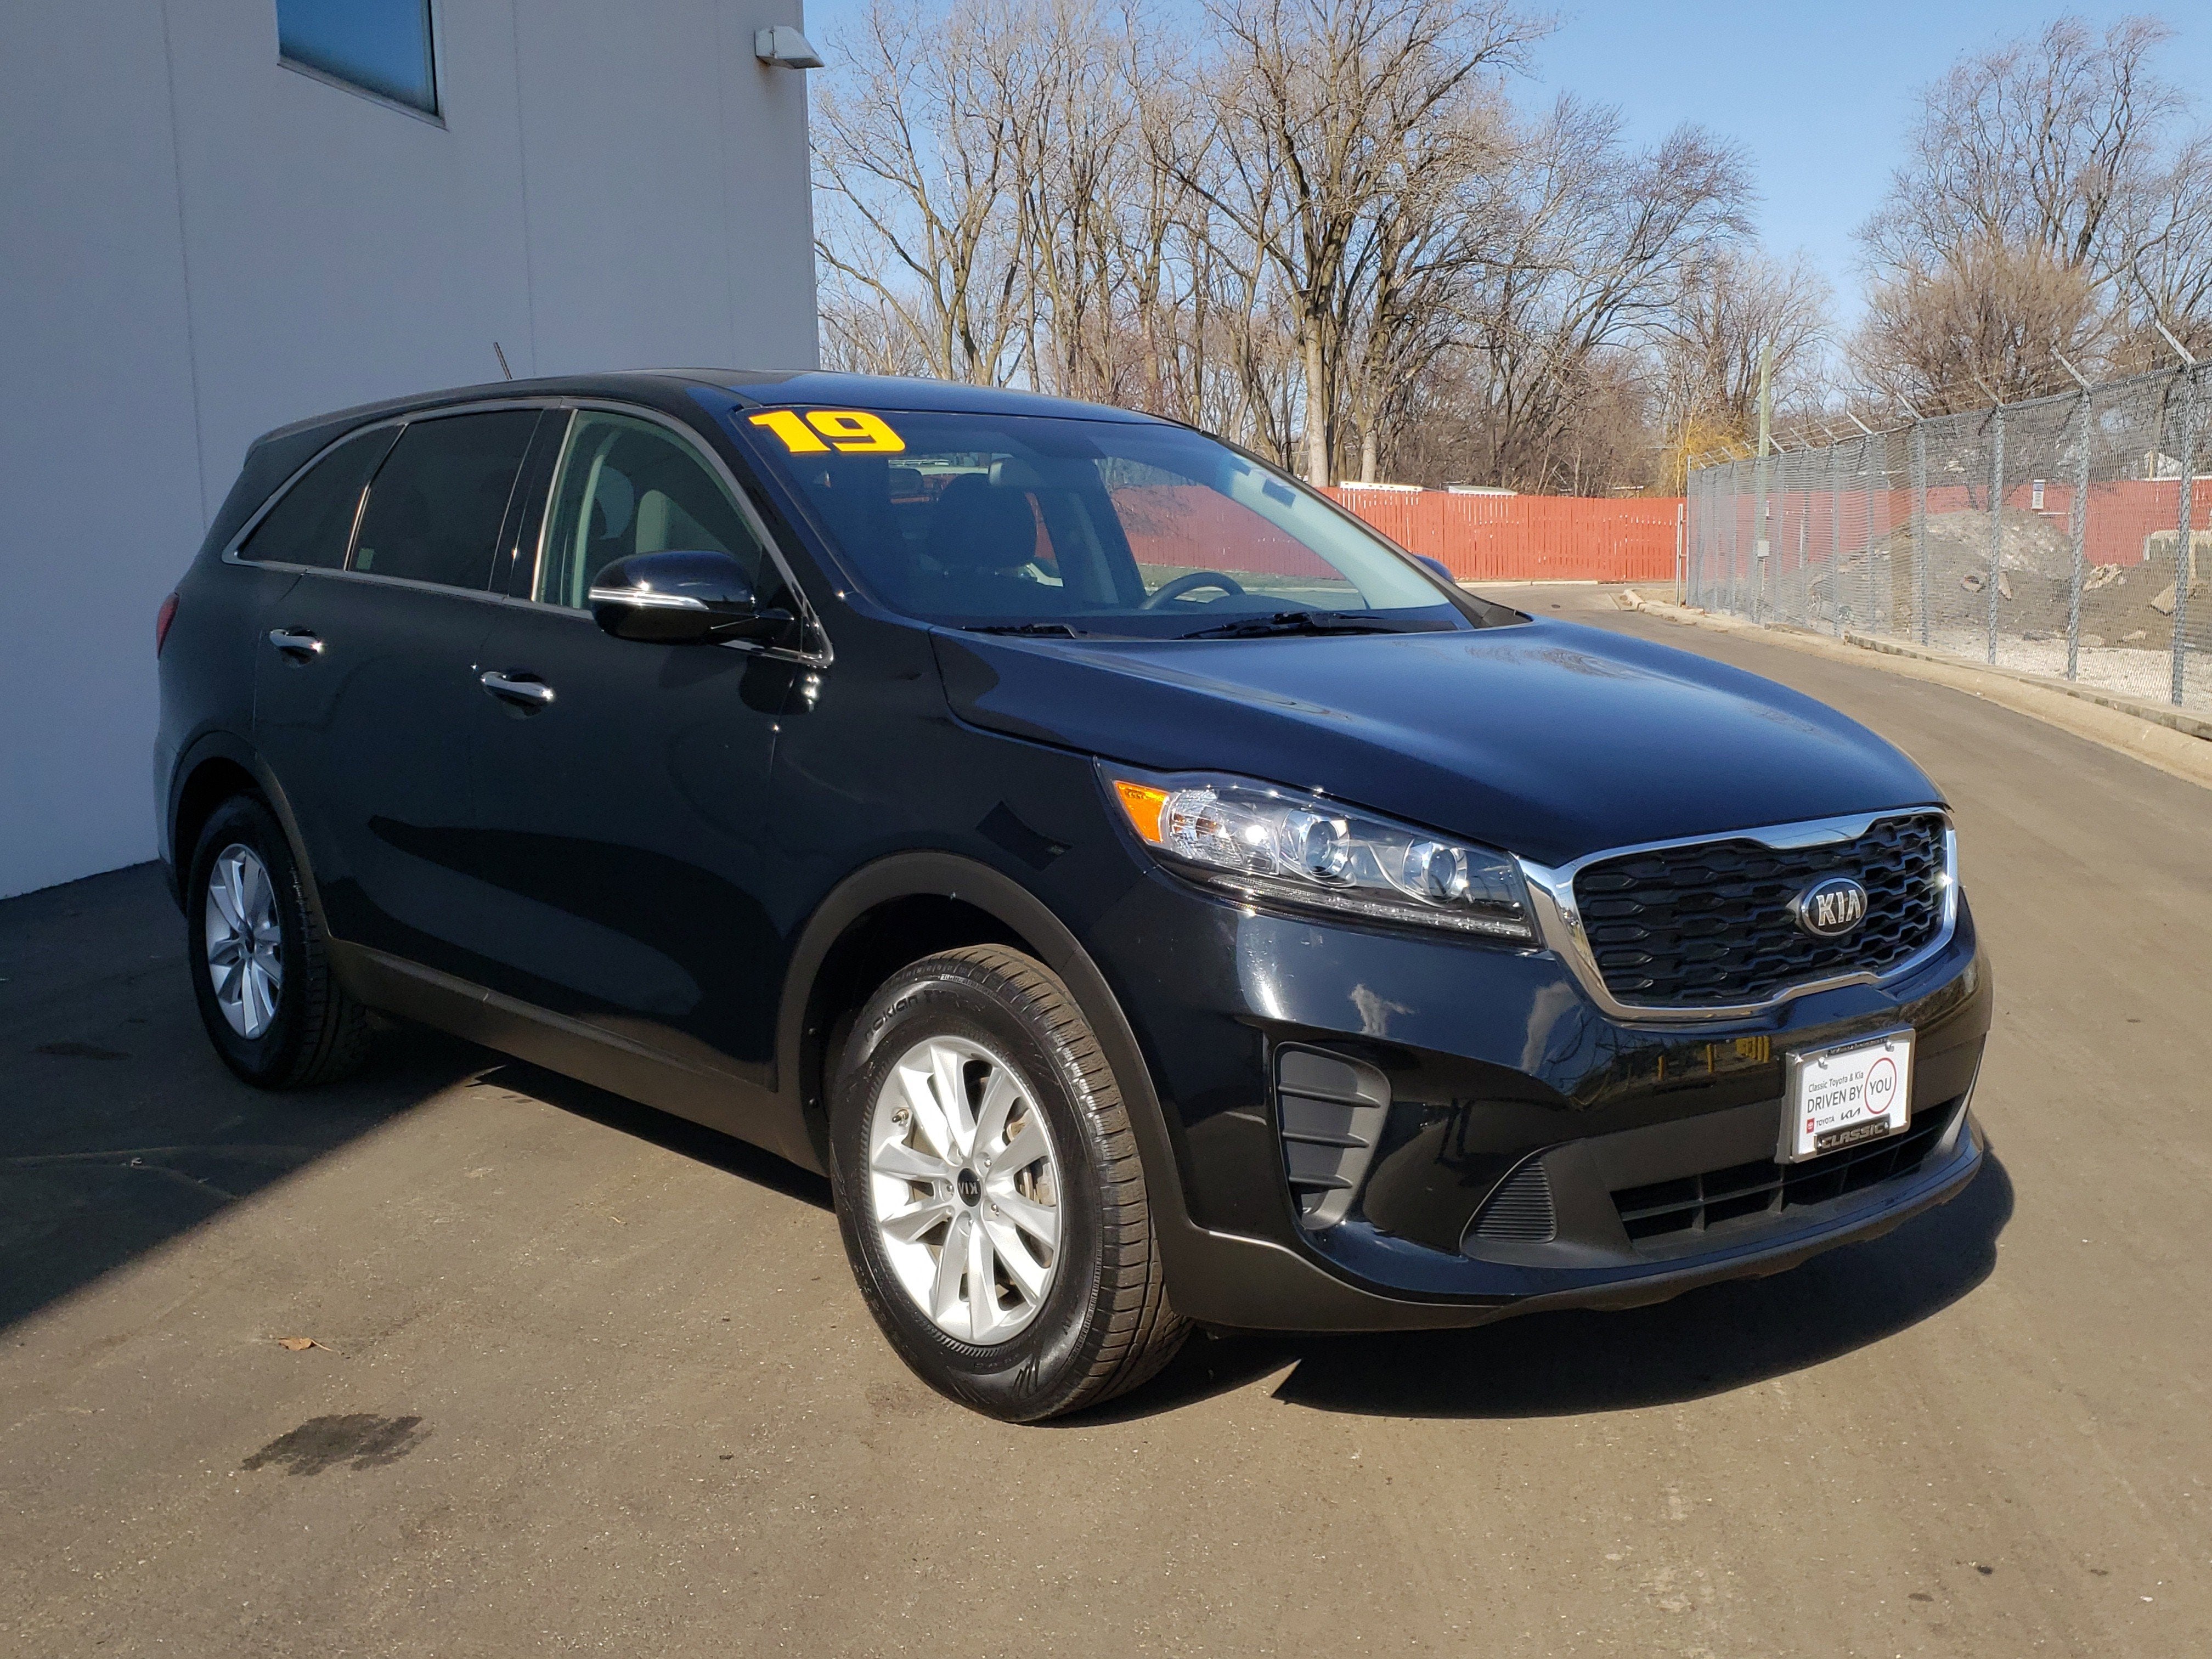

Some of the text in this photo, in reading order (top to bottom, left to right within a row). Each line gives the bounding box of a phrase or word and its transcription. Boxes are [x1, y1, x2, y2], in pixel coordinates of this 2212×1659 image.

[748, 410, 905, 453] 19
[1816, 889, 1861, 927] KIA
[1807, 1077, 1892, 1113] DRIVEN BY YOU
[1808, 1071, 1864, 1093] Classic Toyota & Kia
[1816, 1115, 1835, 1127] TOYOTA
[1822, 1122, 1884, 1149] CLASSIC
[958, 1182, 978, 1195] KIA
